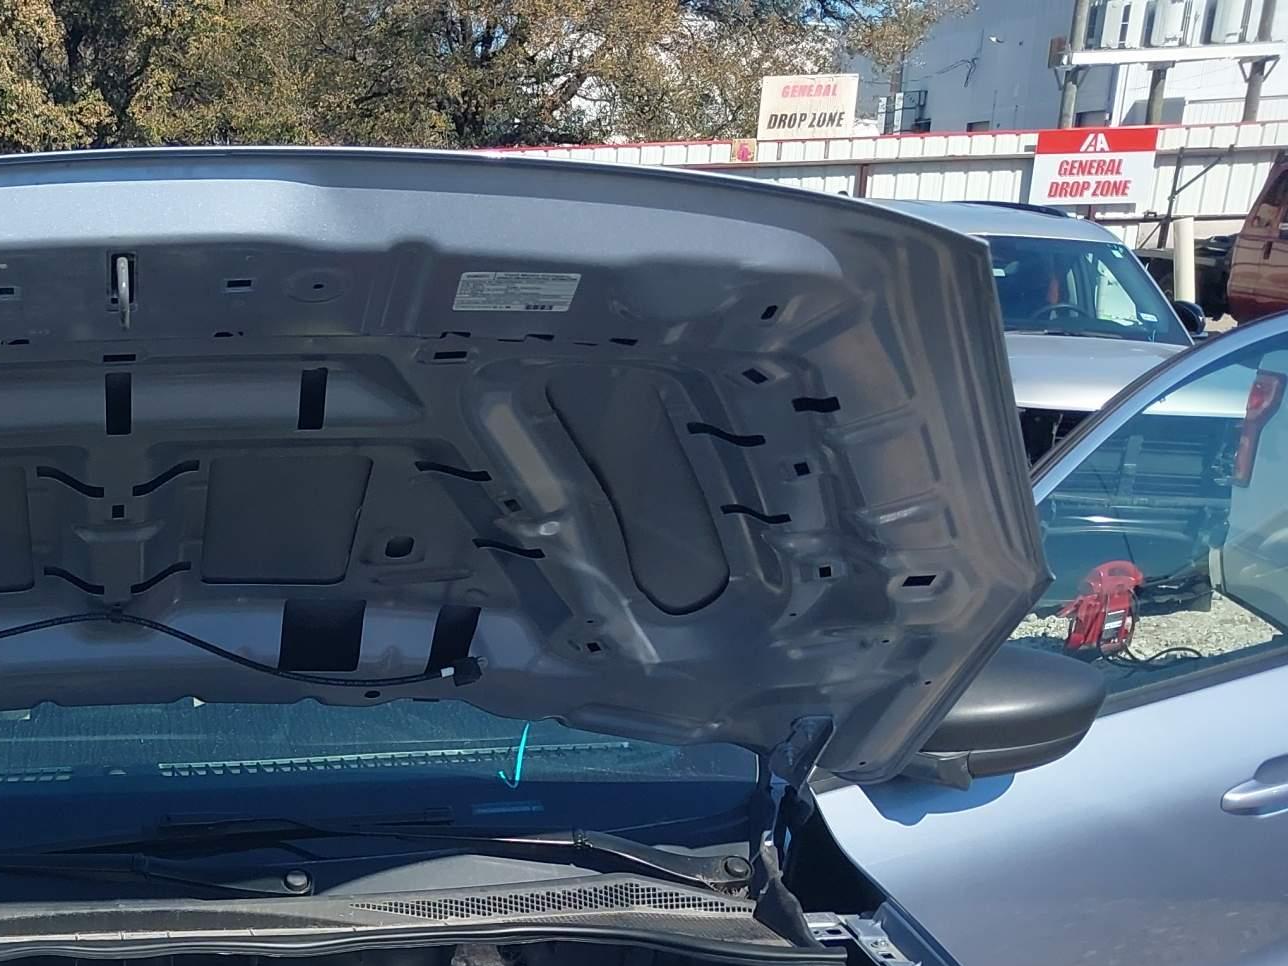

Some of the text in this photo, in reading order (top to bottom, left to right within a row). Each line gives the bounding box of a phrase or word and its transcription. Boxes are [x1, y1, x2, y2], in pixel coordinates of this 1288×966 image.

[781, 84, 838, 98] GENERAL
[767, 111, 845, 129] DROP ZONE
[1058, 159, 1123, 177] GENERAL
[1048, 180, 1132, 198] DROP ZONE
